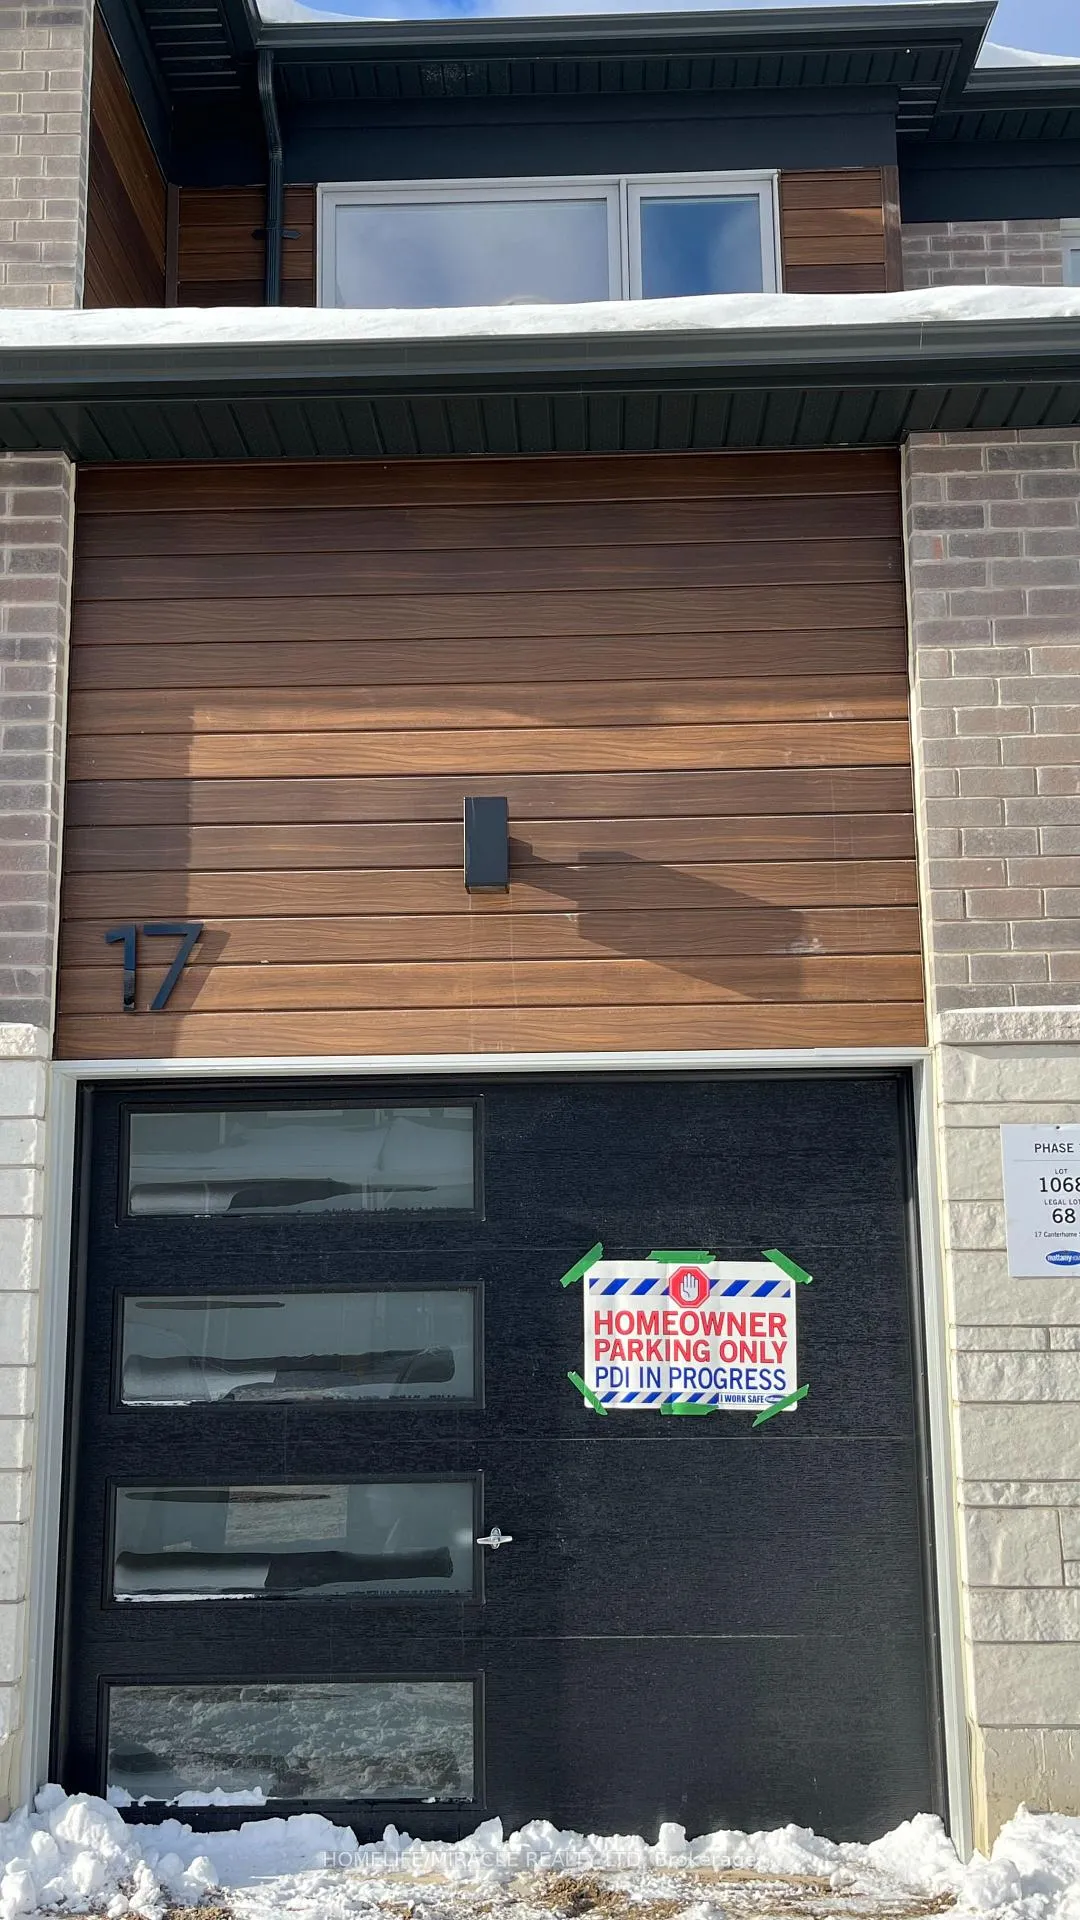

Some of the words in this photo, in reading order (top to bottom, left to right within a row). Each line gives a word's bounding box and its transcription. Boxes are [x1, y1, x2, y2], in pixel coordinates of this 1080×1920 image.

[105, 923, 204, 1011] 17
[1034, 1143, 1074, 1153] PHASE
[1052, 1208, 1076, 1224] 68
[594, 1310, 788, 1338] HOMEOWNER
[594, 1338, 710, 1362] PARKING
[719, 1340, 788, 1364] ONLY
[595, 1366, 630, 1388] PDI
[639, 1366, 661, 1388] IN
[669, 1366, 787, 1391] PROGRESS
[724, 1394, 747, 1403] WORK
[747, 1394, 765, 1403] SAFE
